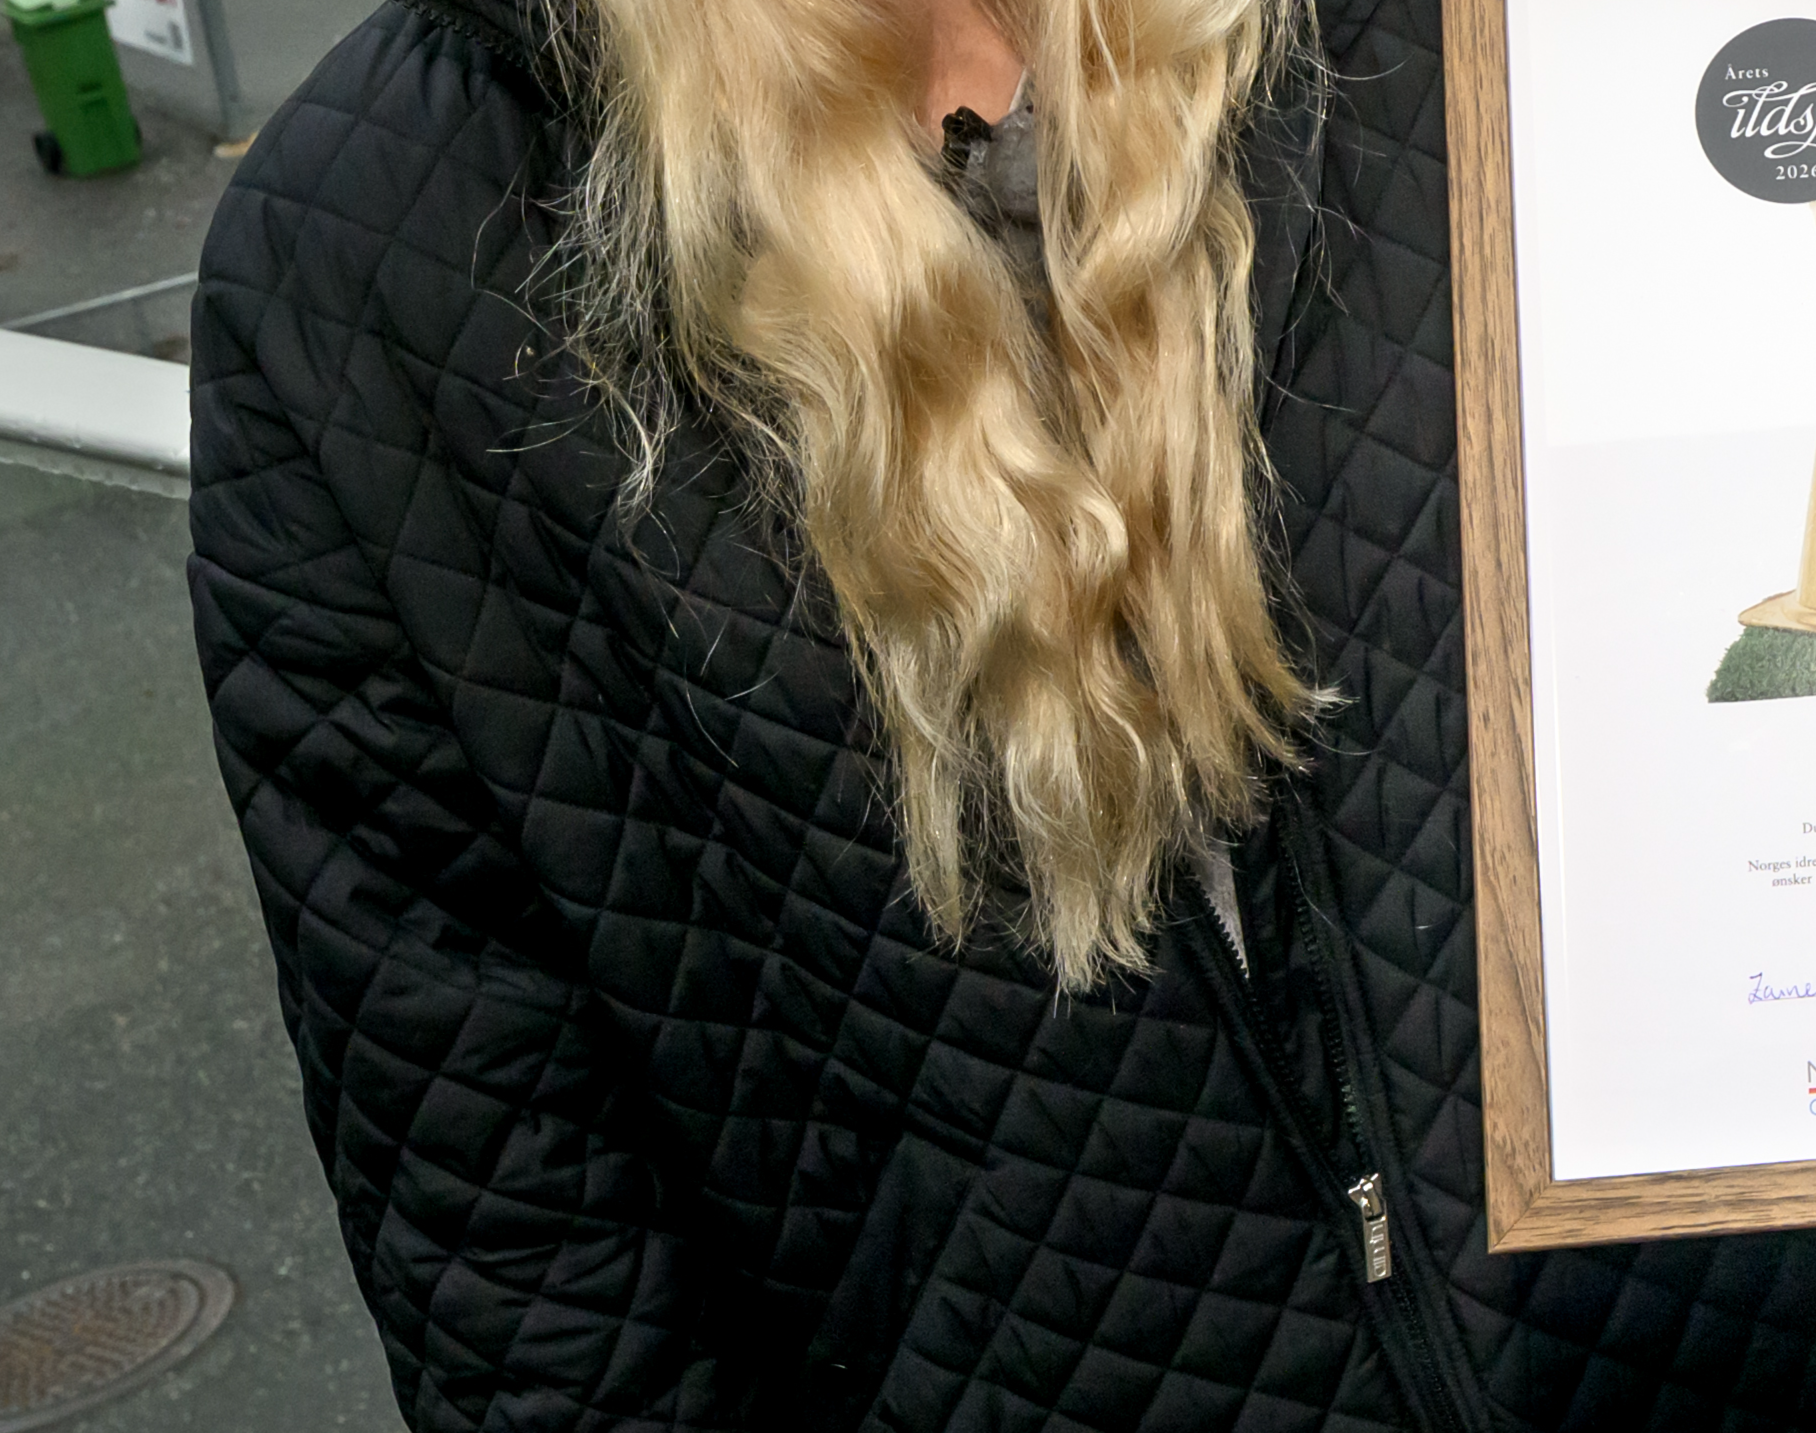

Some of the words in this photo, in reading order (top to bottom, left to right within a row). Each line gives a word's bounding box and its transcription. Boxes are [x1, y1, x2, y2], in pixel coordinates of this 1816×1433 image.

[1724, 64, 1770, 81] Årets
[1747, 858, 1791, 874] Norges
[1771, 870, 1813, 888] ønsker
